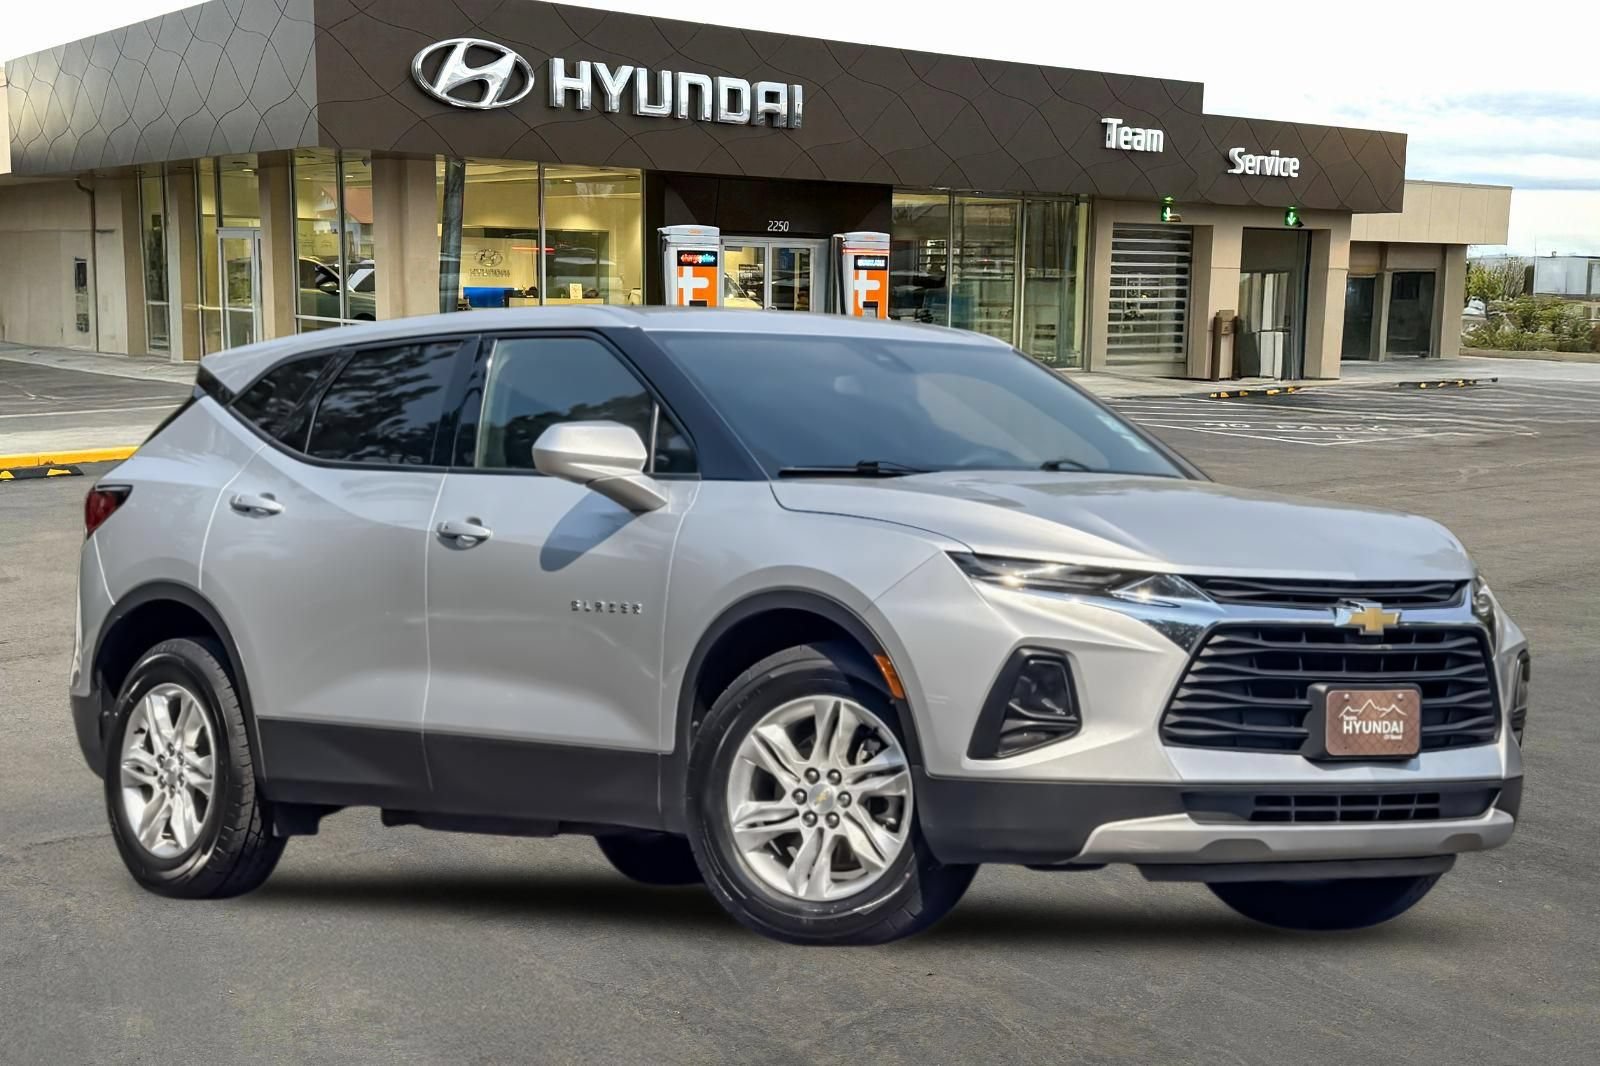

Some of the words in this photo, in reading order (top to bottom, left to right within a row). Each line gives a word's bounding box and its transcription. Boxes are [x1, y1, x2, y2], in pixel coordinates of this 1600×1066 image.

[549, 57, 803, 129] HYUNDAI
[1101, 117, 1164, 153] Team
[1227, 147, 1300, 178] Service
[767, 220, 790, 232] 2250
[1343, 720, 1404, 734] HYUNDAI
